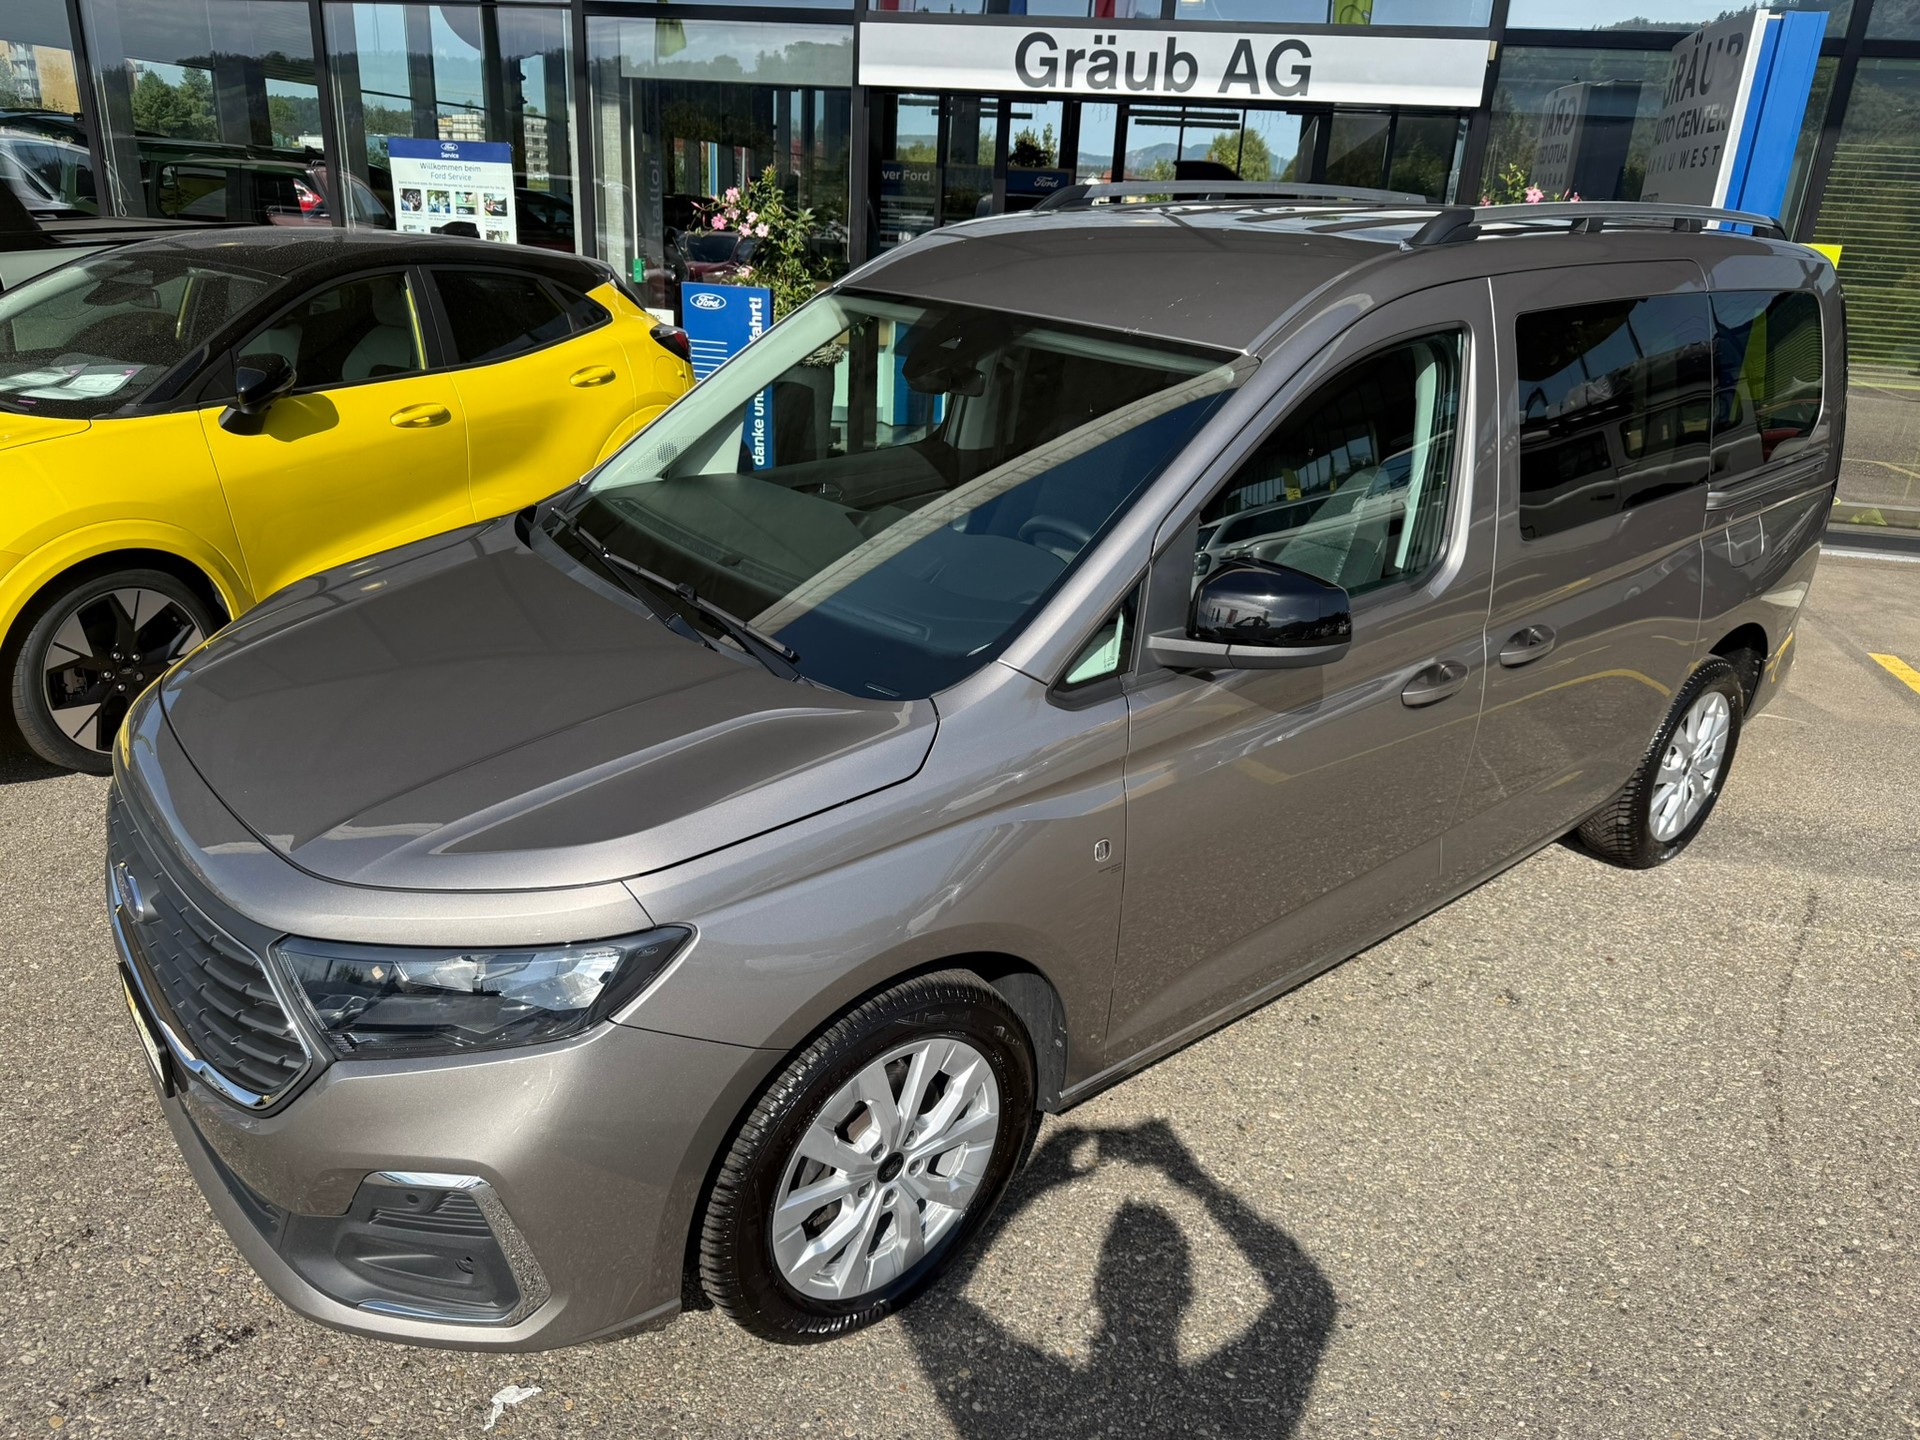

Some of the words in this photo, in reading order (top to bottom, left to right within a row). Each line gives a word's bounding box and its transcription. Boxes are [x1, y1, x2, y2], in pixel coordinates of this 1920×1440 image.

[1015, 31, 1199, 94] Gräub
[1217, 38, 1312, 97] AG
[1679, 145, 1720, 169] WEST
[420, 162, 463, 172] Willkommen
[464, 165, 482, 173] beim
[430, 172, 446, 180] Ford
[448, 172, 472, 181] Service
[903, 169, 930, 181] Ford
[1034, 176, 1059, 188] Ford
[751, 418, 765, 466] danke
